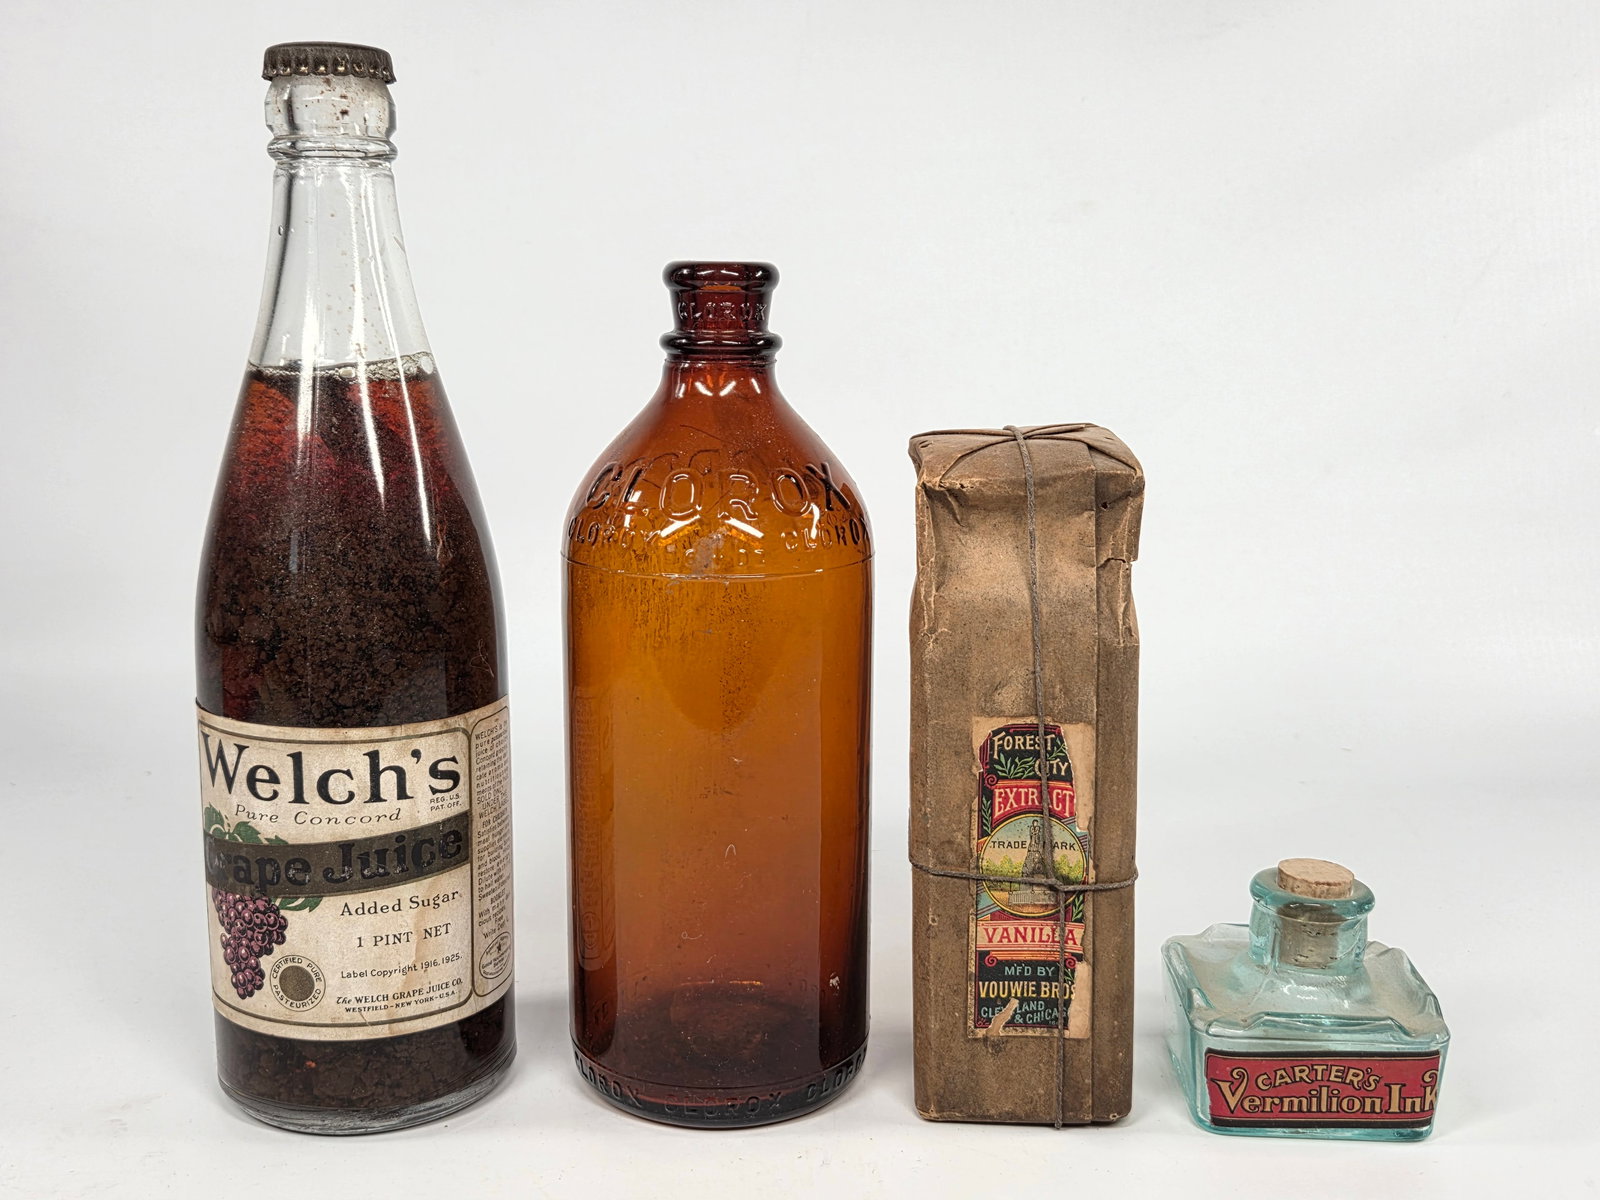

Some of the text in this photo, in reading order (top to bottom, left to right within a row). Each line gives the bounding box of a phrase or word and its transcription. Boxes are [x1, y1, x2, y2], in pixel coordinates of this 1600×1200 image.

[586, 462, 851, 521] CLOROX
[992, 731, 1056, 759] FOREST
[201, 731, 460, 805] Welch's
[1034, 758, 1069, 777] CTY
[235, 804, 402, 825] Pure Concord
[993, 787, 1074, 818] EXTRCT
[323, 829, 463, 885] Juice
[991, 840, 1076, 851] TRADE ARK
[340, 890, 459, 917] Added Sugar
[357, 922, 452, 948] 1 PINT NET
[984, 925, 1078, 946] VANILLA
[272, 957, 322, 982] CERTIFIED PURE
[341, 969, 368, 979] Label
[370, 962, 418, 978] Copyright
[1037, 966, 1055, 976] BY
[273, 984, 321, 1008] PASTEURIZED
[336, 996, 352, 1005] The
[354, 993, 389, 1004] WELCH
[392, 988, 424, 1001] GRAPE
[426, 981, 451, 995] JUICE
[979, 981, 1037, 999] VOUWIE
[1014, 1013, 1023, 1024] &
[1211, 1068, 1438, 1115] Vermilion Ink
